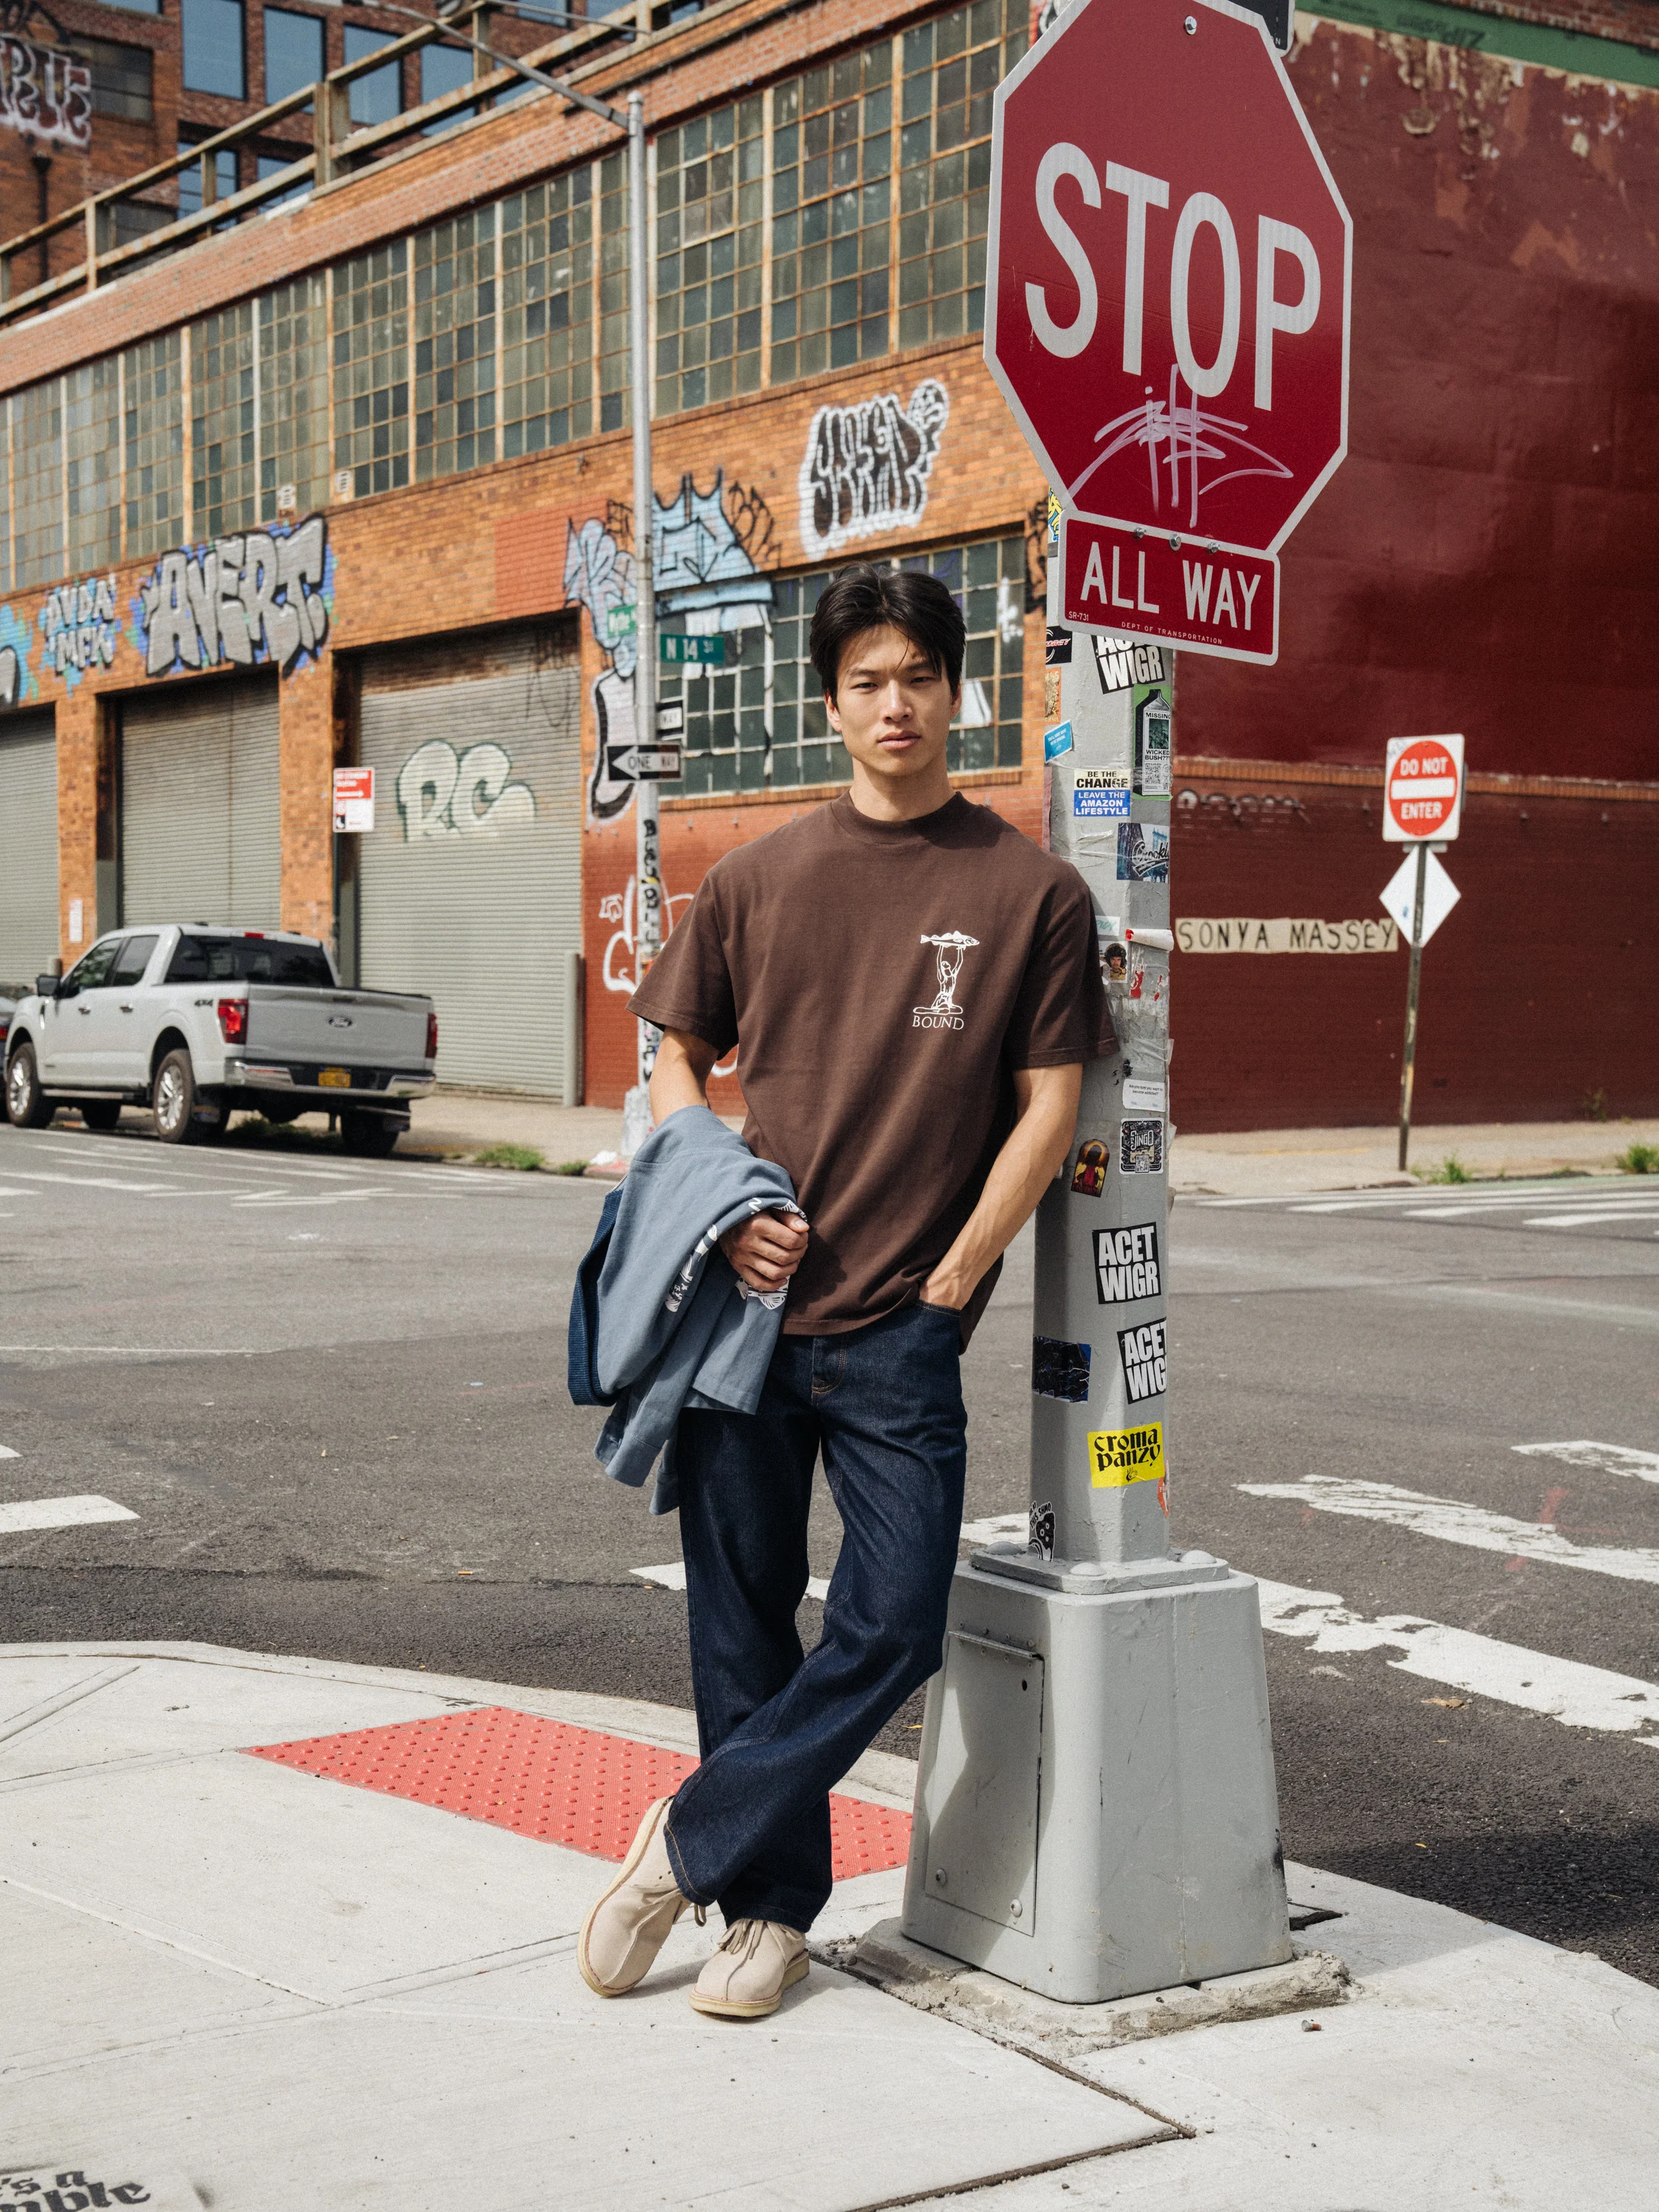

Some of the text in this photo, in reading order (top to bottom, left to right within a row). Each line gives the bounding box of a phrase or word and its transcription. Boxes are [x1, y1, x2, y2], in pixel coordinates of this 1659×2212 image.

[1025, 142, 1321, 411] STOP
[1080, 541, 1262, 630] ALL WAY
[1068, 611, 1089, 622] SR-731
[1121, 622, 1141, 630] DEPT
[1158, 627, 1222, 644] TRANSPORTATION
[666, 637, 677, 660] N
[682, 638, 699, 661] 14
[1099, 645, 1163, 691] WIGR
[627, 755, 650, 771] ONE
[1400, 757, 1449, 776] DO NOT
[1076, 778, 1129, 788] CHANGE
[1401, 801, 1443, 820] ENTER
[1178, 921, 1395, 950] SONYA MASSEY
[912, 1015, 964, 1030] BOUND
[1099, 1225, 1155, 1267] ACET
[1099, 1261, 1159, 1302] WIGR
[1093, 1428, 1158, 1453] croma
[1096, 1444, 1161, 1472] panzy
[1030, 1512, 1039, 1529] THIS
